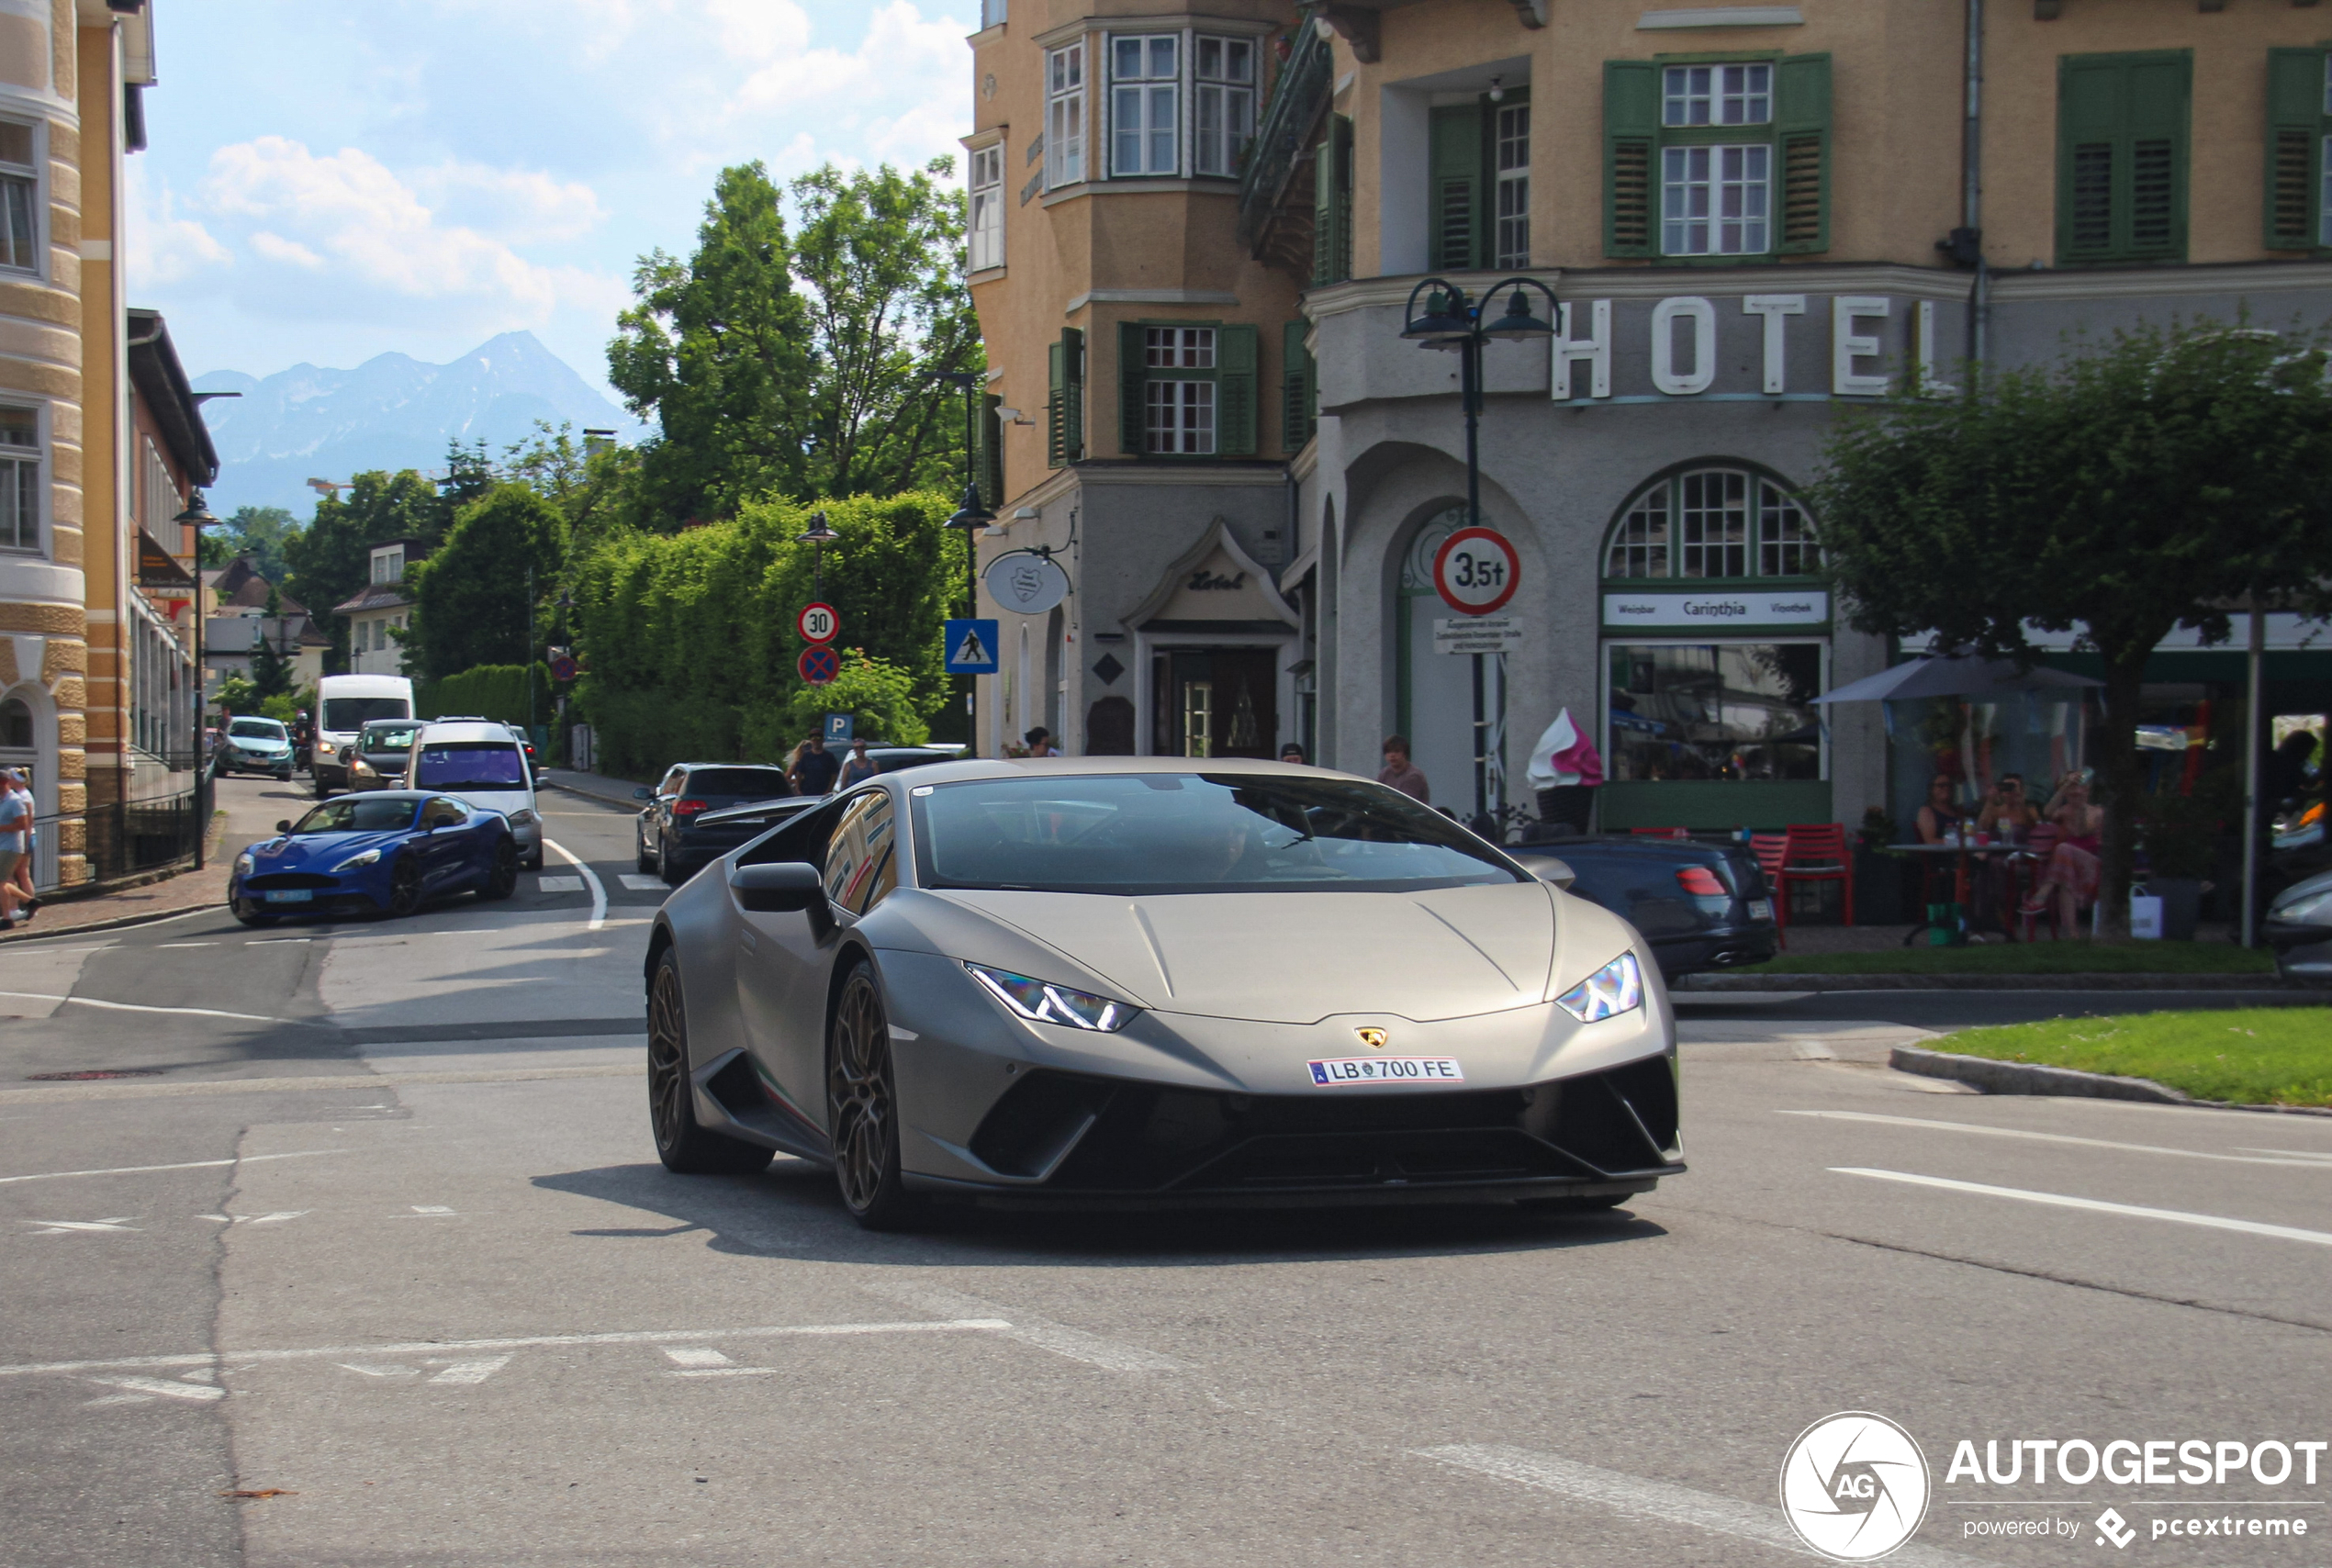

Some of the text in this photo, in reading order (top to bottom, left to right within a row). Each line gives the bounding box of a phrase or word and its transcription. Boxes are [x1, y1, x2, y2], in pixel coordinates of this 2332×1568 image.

[1552, 295, 1957, 400] HOTEL
[1455, 552, 1504, 588] 3,5t
[1618, 600, 1812, 618] Weinbar Carinthia Vinothek
[809, 613, 828, 633] 30
[832, 717, 845, 734] P
[1329, 1061, 1455, 1080] LB 700 FE
